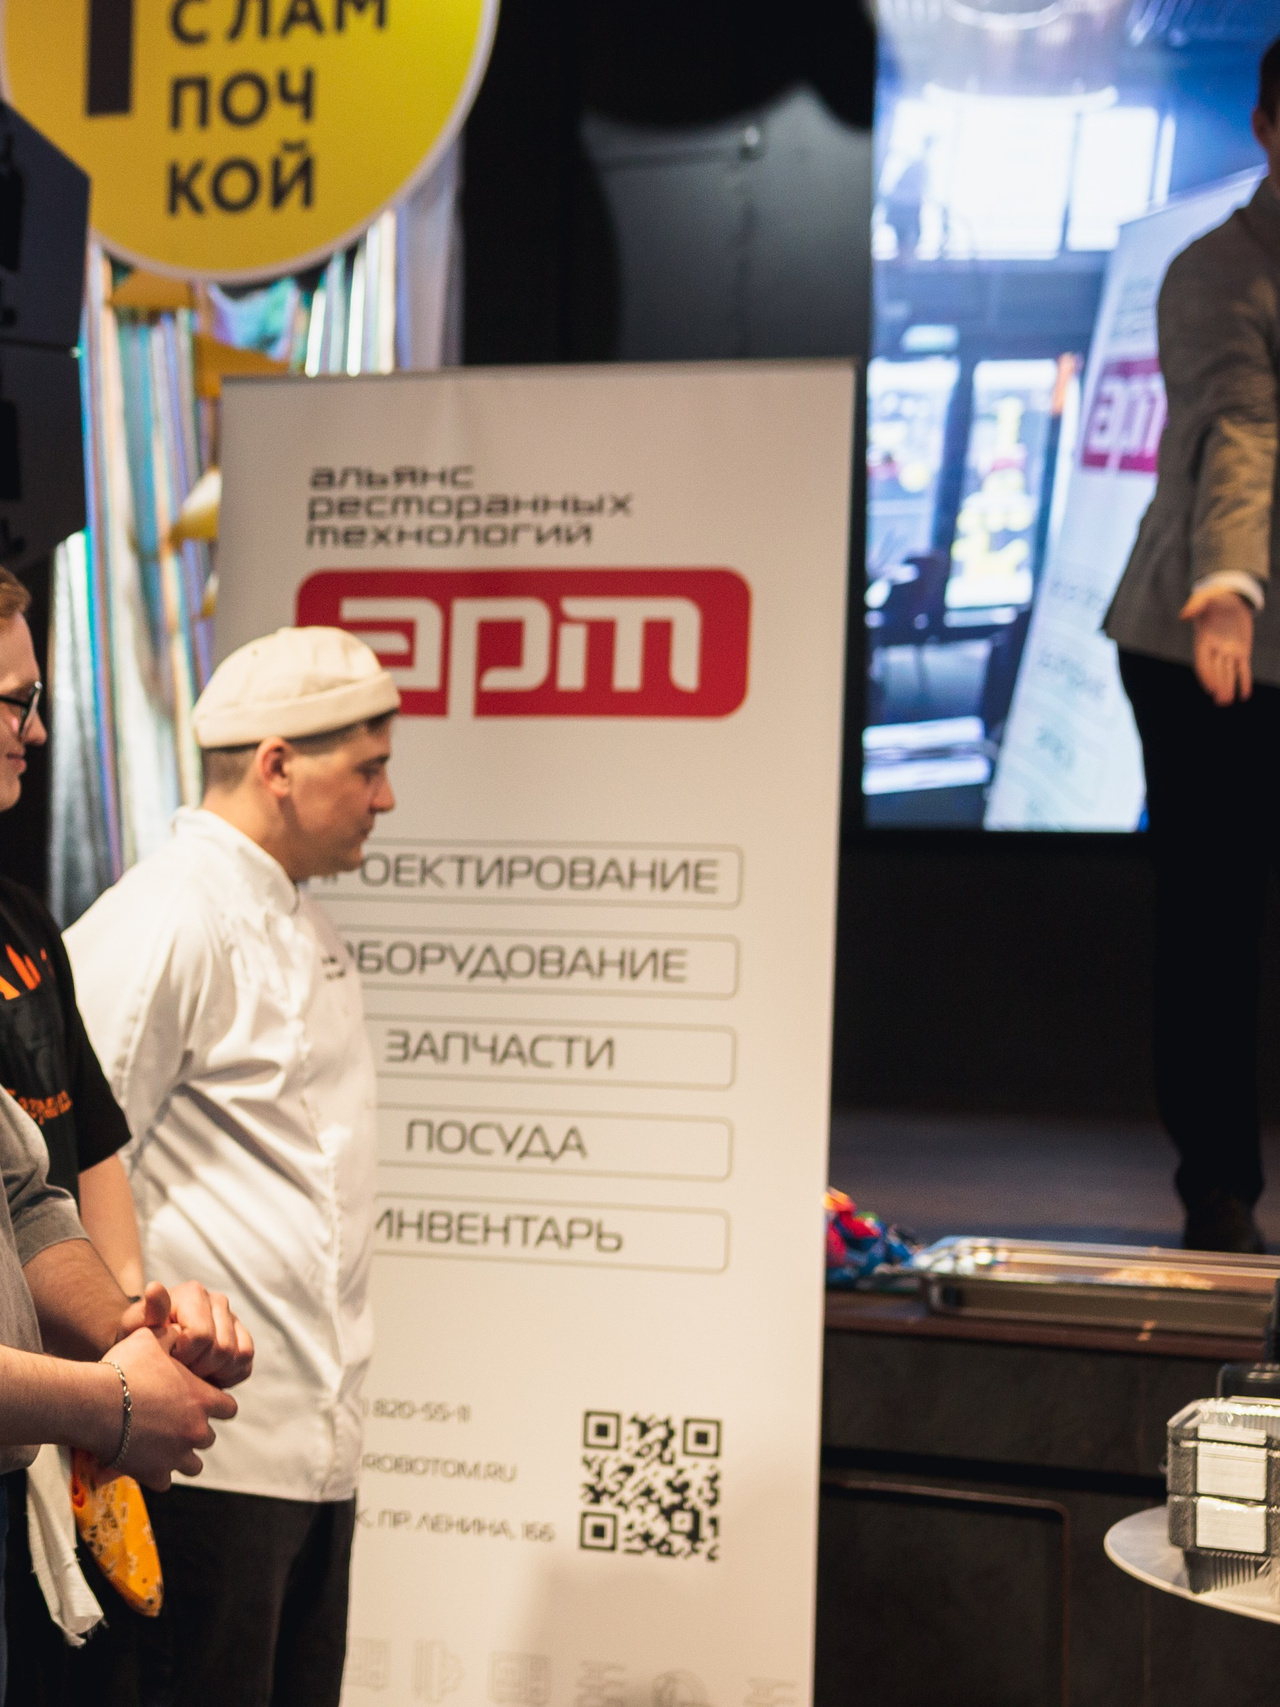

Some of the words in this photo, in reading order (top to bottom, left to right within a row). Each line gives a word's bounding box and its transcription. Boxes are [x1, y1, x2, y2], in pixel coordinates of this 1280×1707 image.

[169, 67, 316, 131] ПОЧ
[166, 140, 316, 217] КОЙ
[310, 465, 475, 491] альянс
[307, 492, 633, 522] ресторанных
[306, 521, 593, 548] технологий
[320, 851, 719, 895] ОЕКТИРОВАНИЕ
[384, 1027, 616, 1070] ЗАПЧАСТИ
[405, 1117, 588, 1164] ПОСУДА
[376, 1208, 624, 1254] ИНВЕНТАРЬ
